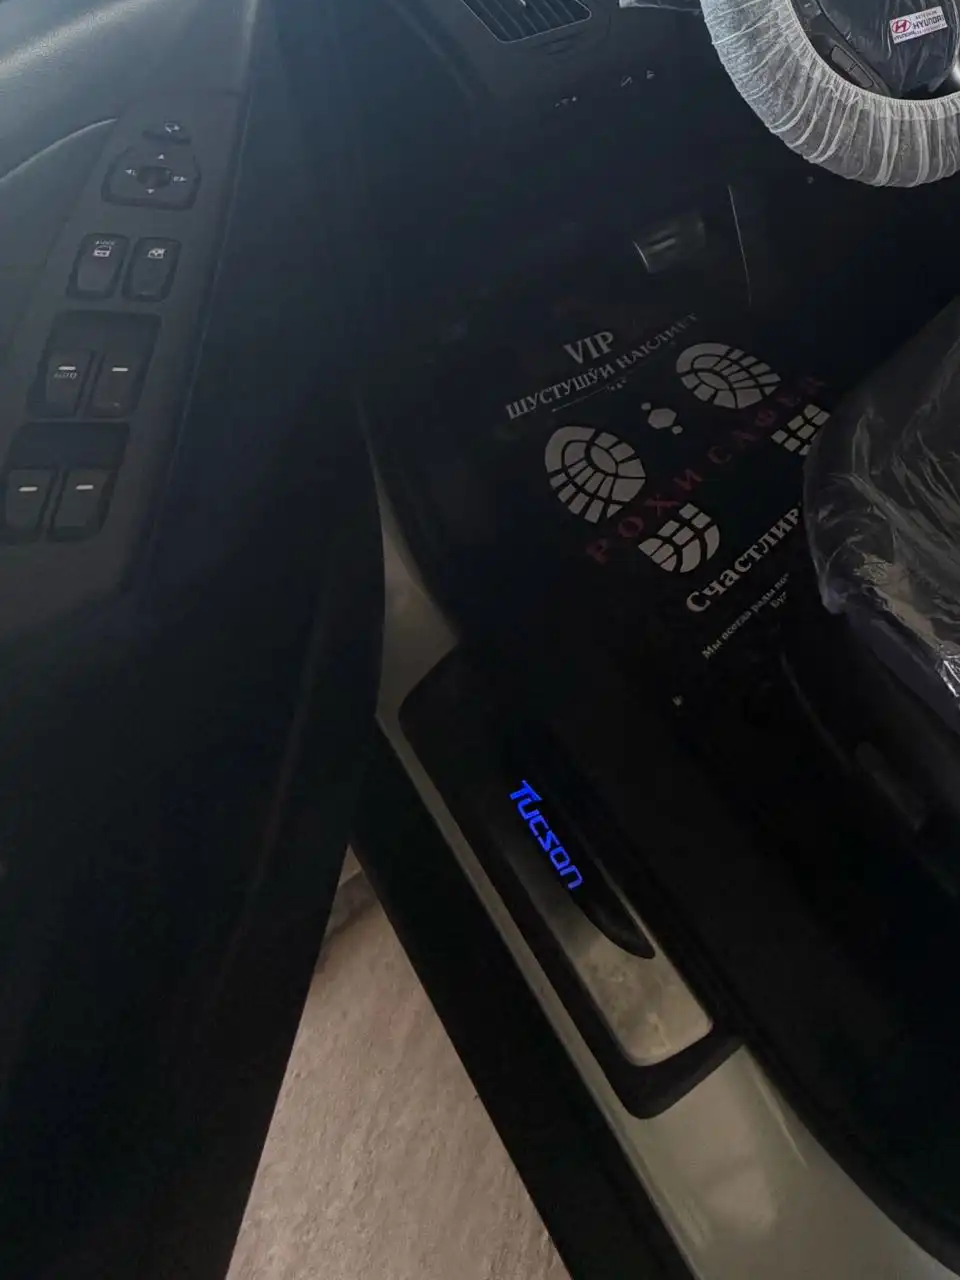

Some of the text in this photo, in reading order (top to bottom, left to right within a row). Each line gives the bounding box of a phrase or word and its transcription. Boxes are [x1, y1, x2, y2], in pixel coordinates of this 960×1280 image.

[912, 14, 945, 29] HYUNDAI
[564, 331, 615, 365] VIP
[685, 502, 802, 612] Счастлив
[509, 779, 584, 891] Tucson
